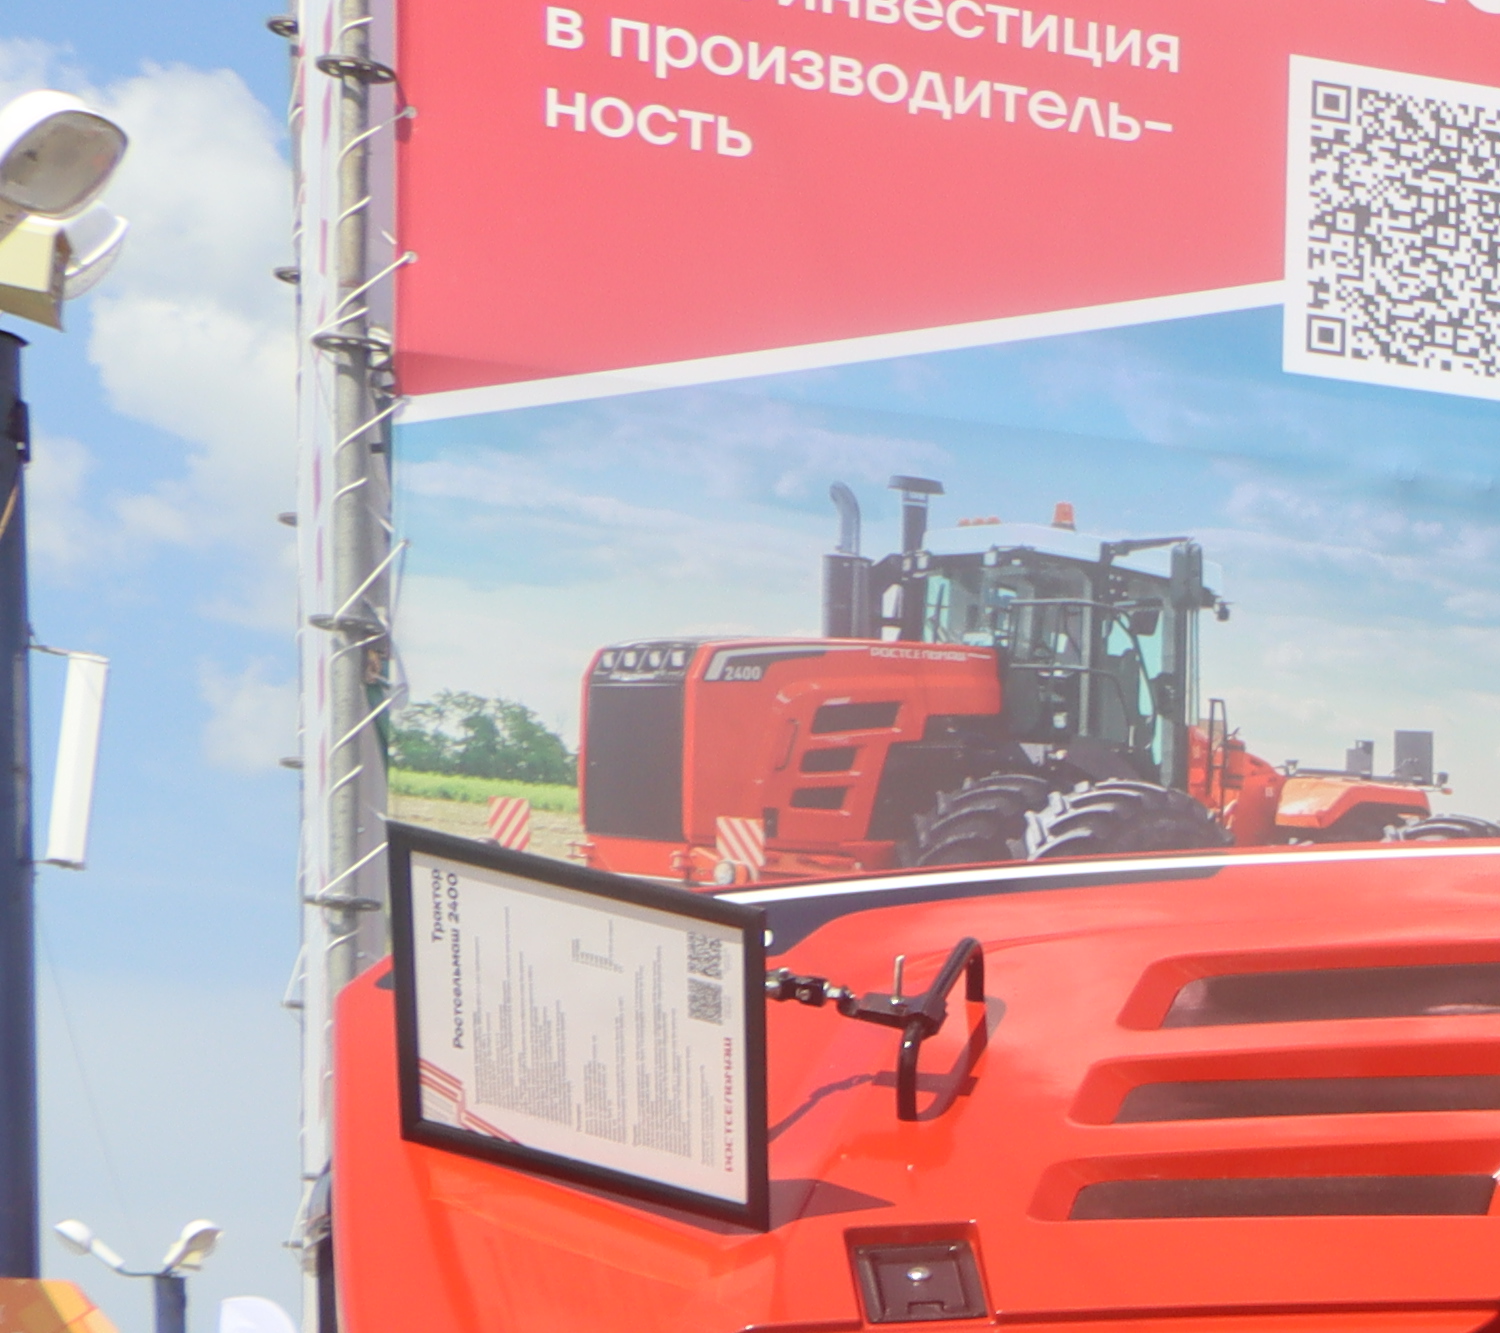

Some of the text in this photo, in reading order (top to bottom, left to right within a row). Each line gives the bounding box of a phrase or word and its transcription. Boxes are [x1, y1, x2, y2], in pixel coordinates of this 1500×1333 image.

[546, 6, 1173, 141] в производитель-
[778, 0, 1180, 73] вестиция
[546, 87, 753, 157] ность
[724, 665, 762, 681] 2400
[430, 868, 443, 944] Трактор
[445, 872, 465, 1050] Ростсельмаш 2400
